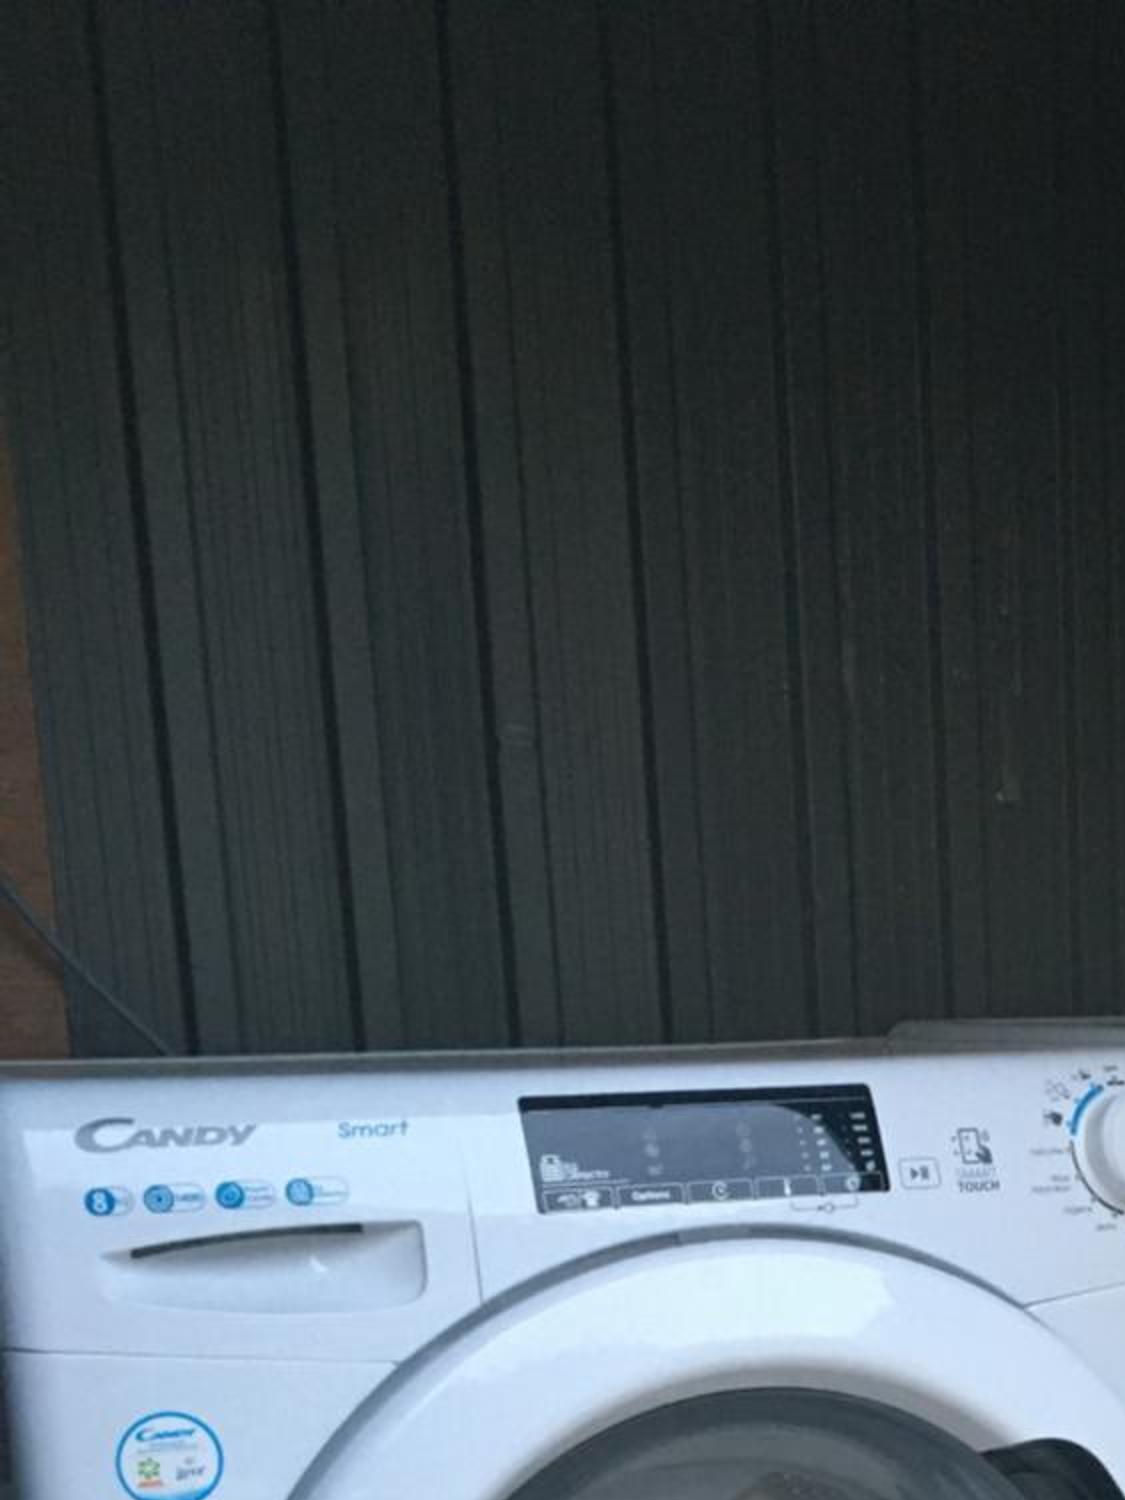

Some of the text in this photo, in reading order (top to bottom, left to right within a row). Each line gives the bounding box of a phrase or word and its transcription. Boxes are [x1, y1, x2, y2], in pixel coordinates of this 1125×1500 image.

[74, 1118, 409, 1154] CANDY Smart
[958, 1180, 1000, 1193] TOUCH
[94, 1188, 107, 1212] 8
